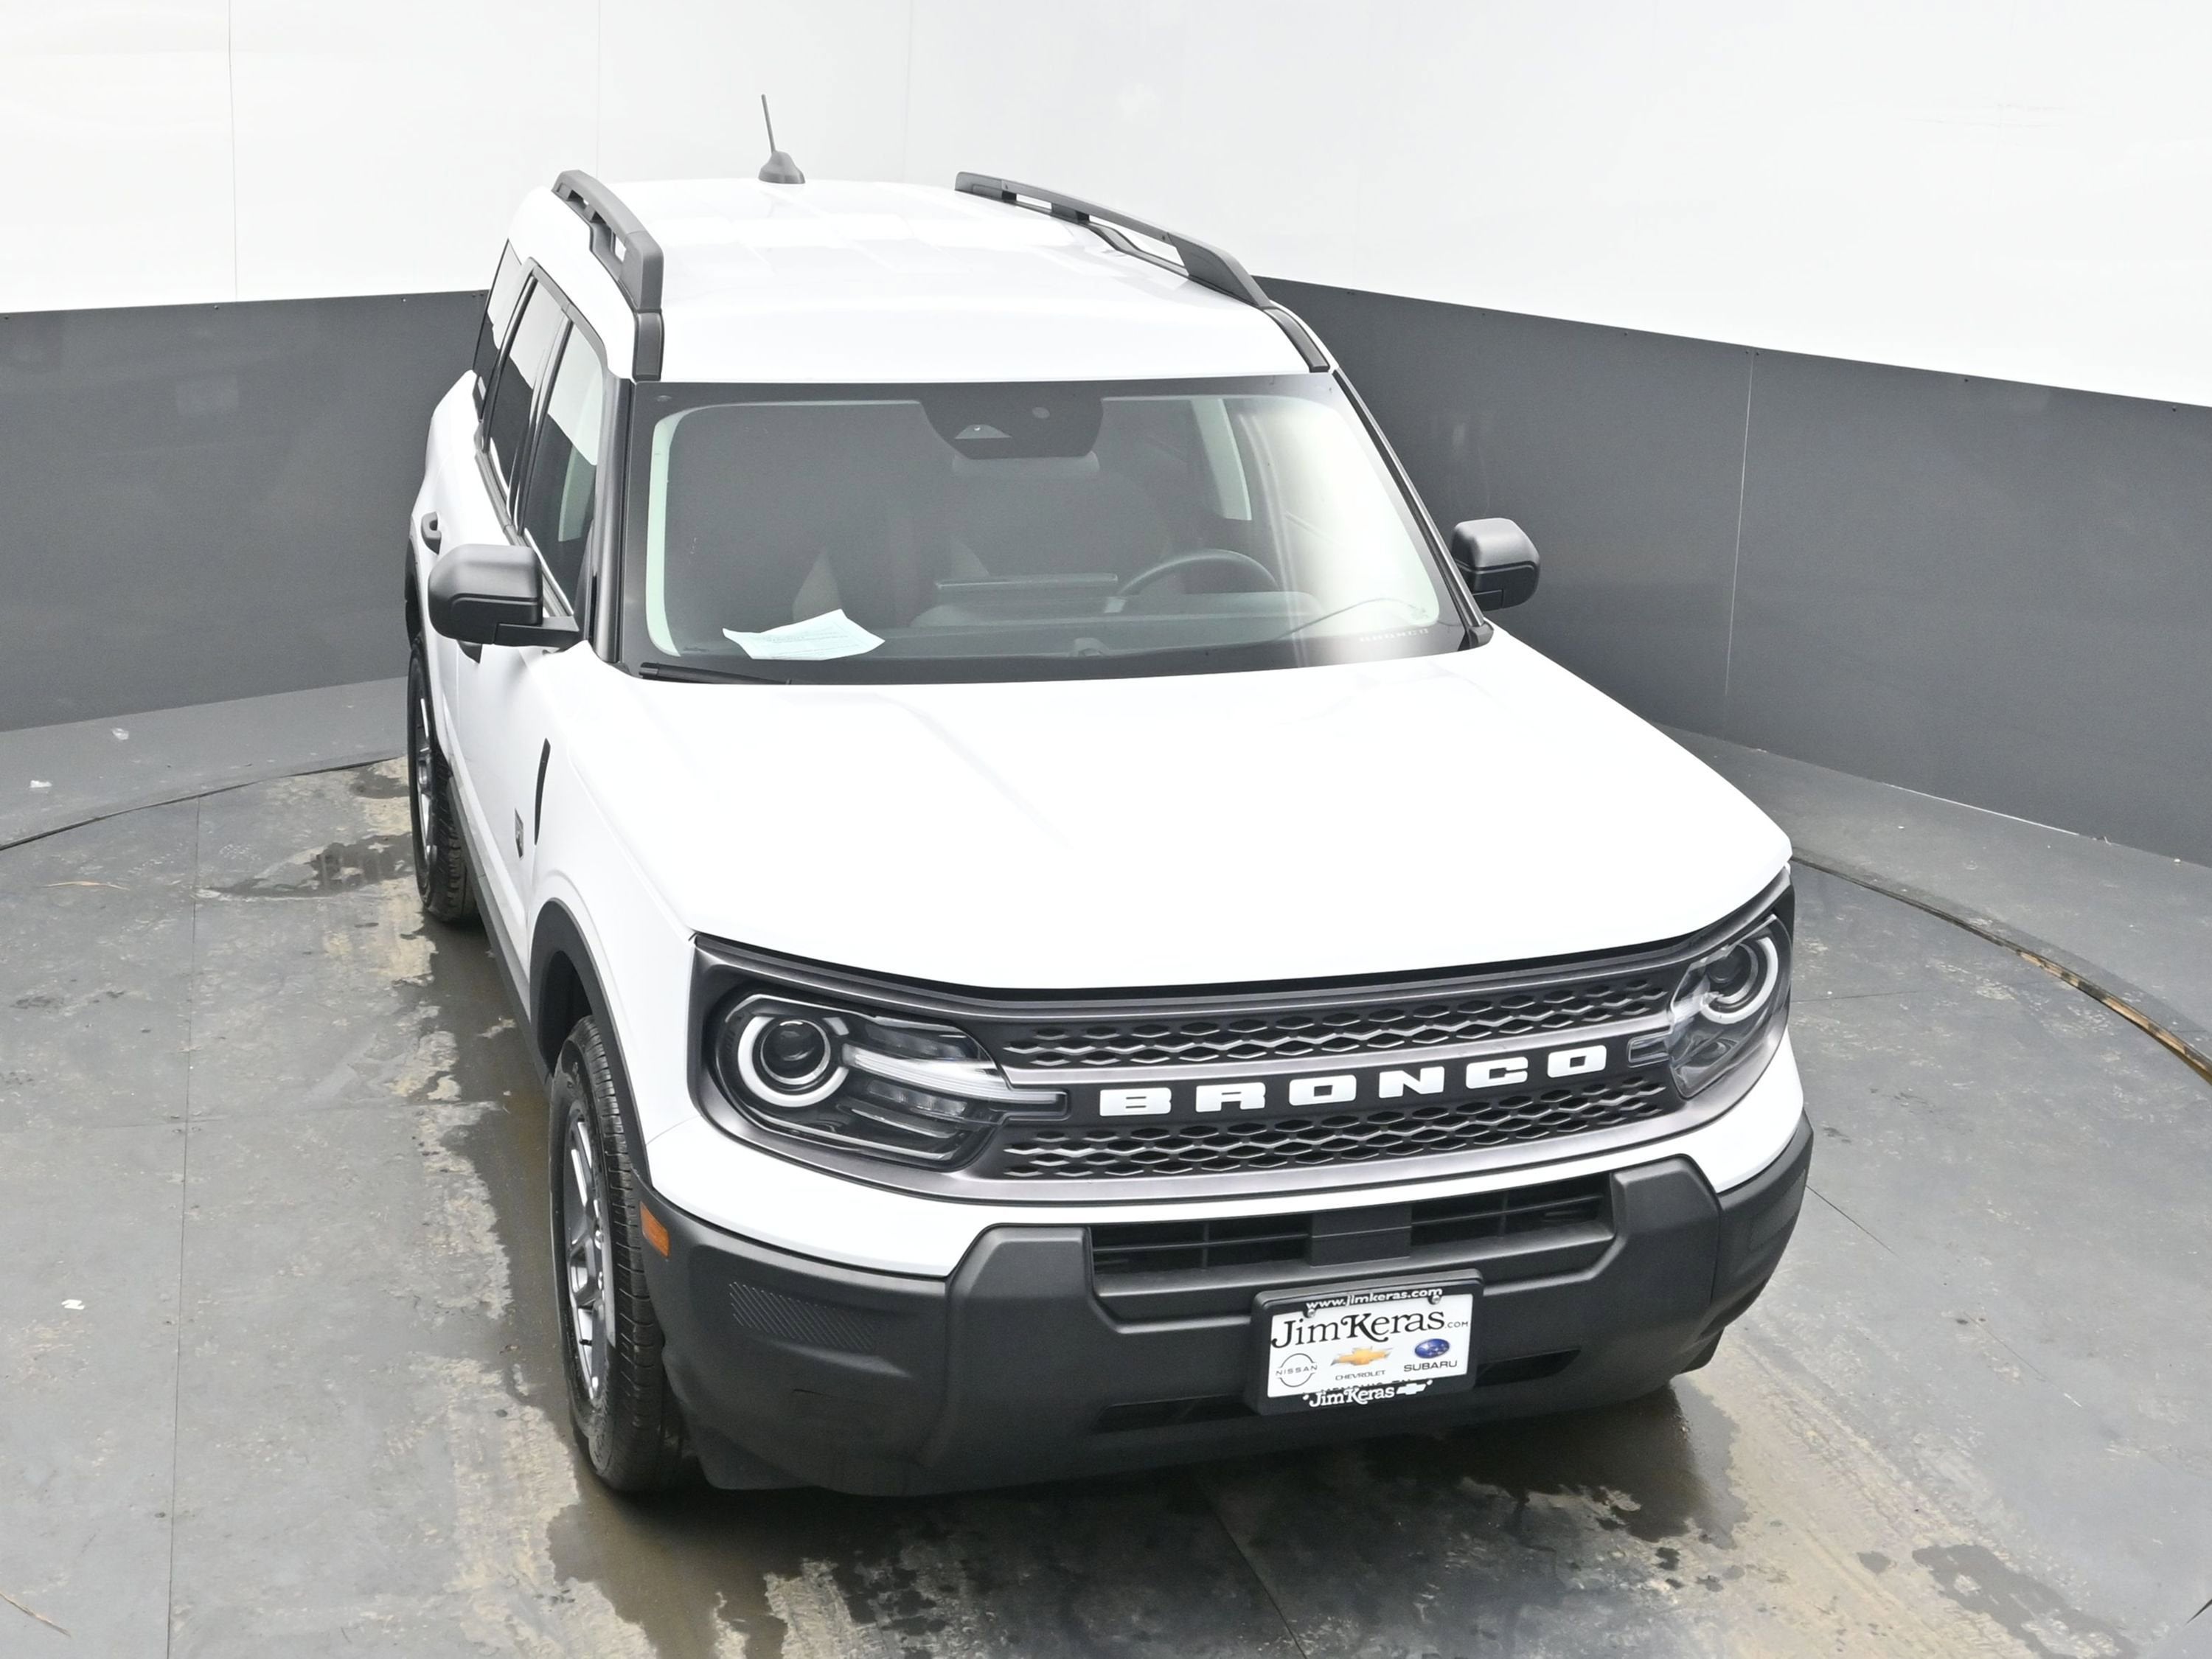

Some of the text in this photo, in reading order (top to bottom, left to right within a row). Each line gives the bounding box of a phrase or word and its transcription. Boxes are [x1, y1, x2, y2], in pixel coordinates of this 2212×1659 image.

[1099, 1045, 1607, 1116] BRONCO
[1306, 1288, 1442, 1310] www.jimkeras.com
[1276, 1365, 1318, 1376] NISSAN
[1404, 1360, 1458, 1372] SUBARU
[1335, 1370, 1385, 1380] CHEVROLET
